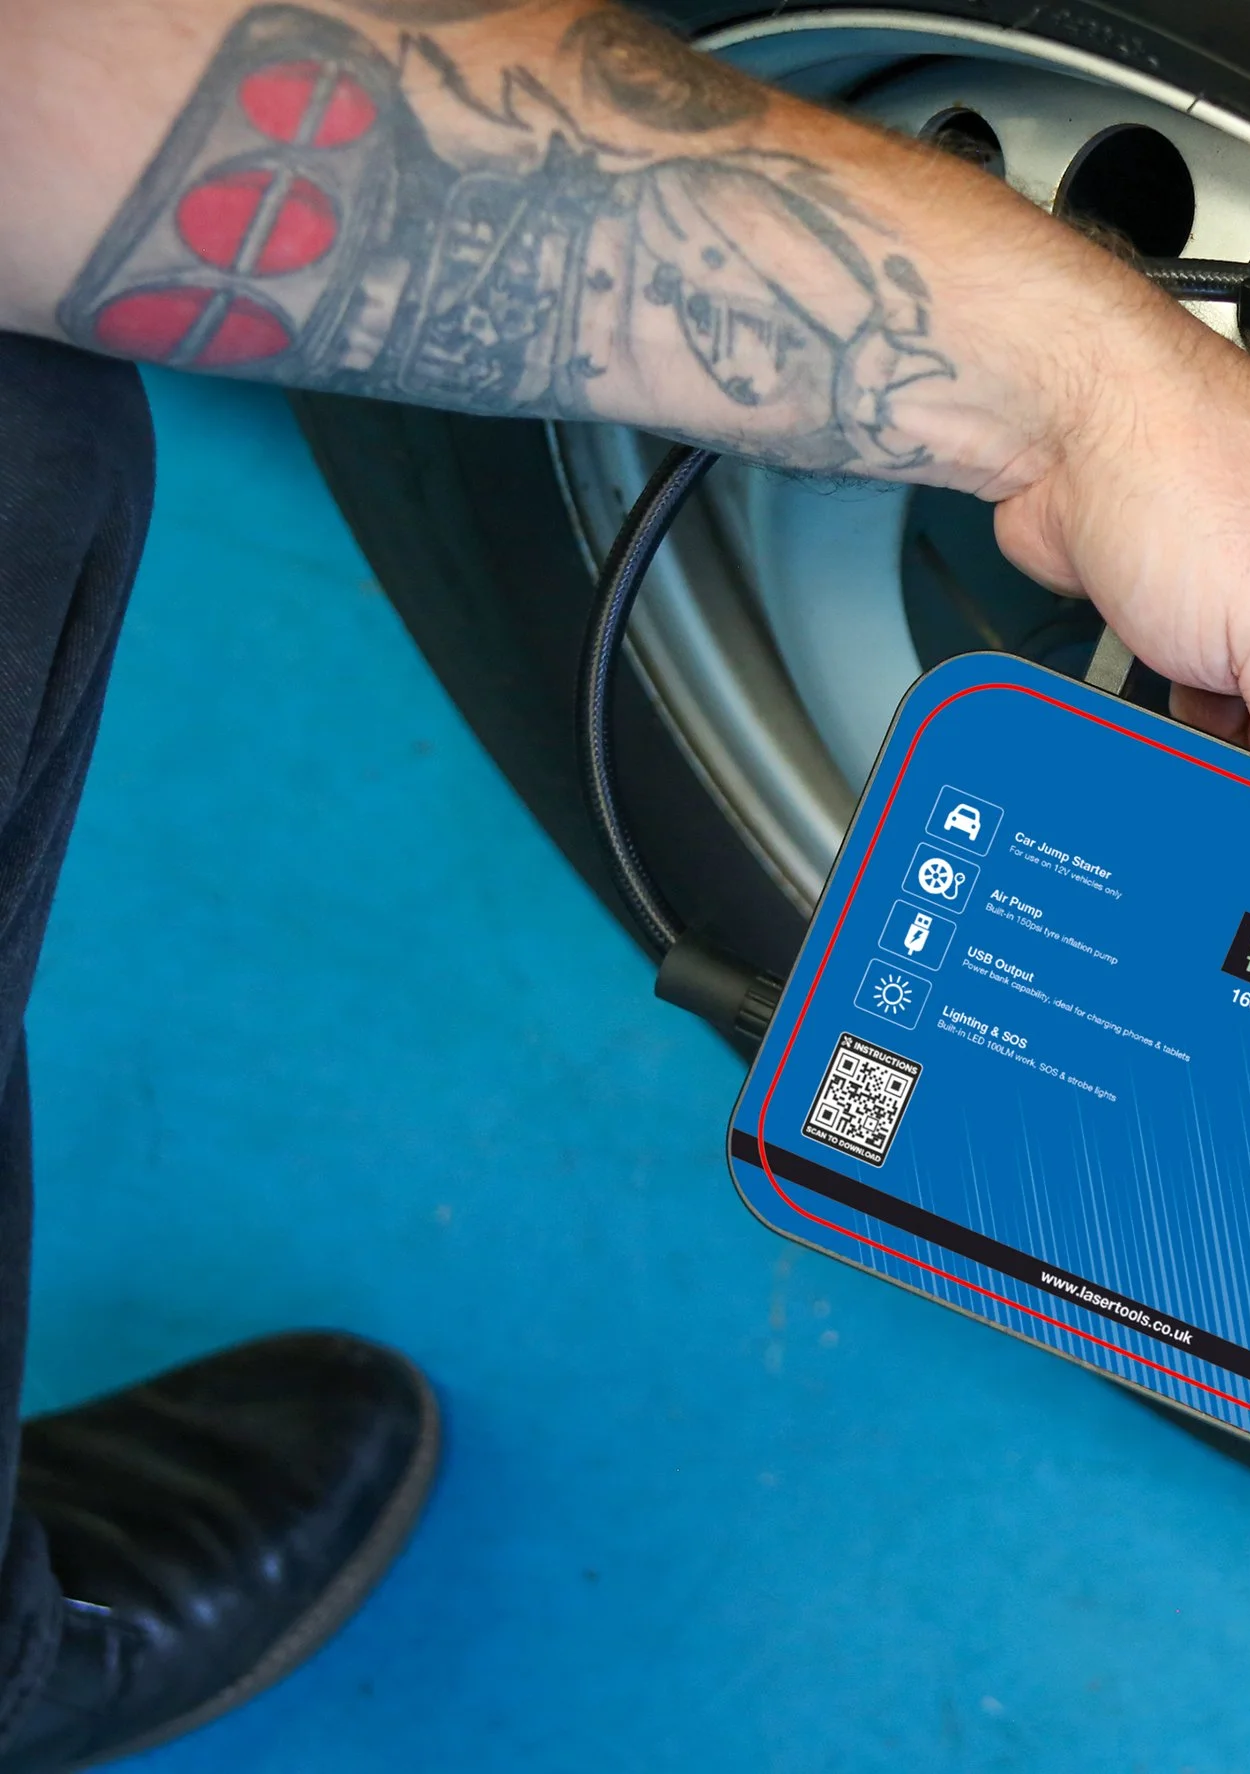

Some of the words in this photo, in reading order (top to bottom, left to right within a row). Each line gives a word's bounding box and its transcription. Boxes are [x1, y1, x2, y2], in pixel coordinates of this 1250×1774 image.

[1009, 845, 1024, 856] For
[1024, 853, 1040, 864] use
[1040, 860, 1052, 869] on
[1054, 864, 1071, 876] 12V
[1070, 873, 1104, 891] vehicles
[1104, 887, 1122, 900] only
[1015, 831, 1036, 848] Car
[1037, 842, 1070, 864] Jump
[1071, 855, 1112, 879] Starter
[990, 889, 1009, 903] Air
[1008, 896, 1043, 919] Pump
[985, 902, 1015, 921] Built-in
[1043, 927, 1061, 940] tyre
[1061, 936, 1093, 954] inflation
[1093, 949, 1119, 965] pump
[967, 946, 994, 965] USB
[994, 958, 1034, 983] Output
[942, 1005, 989, 1035] Lighting
[990, 1026, 999, 1038] &
[1001, 1031, 1028, 1049] SOS
[962, 958, 989, 976] Power
[988, 970, 1010, 985] bank
[1053, 999, 1074, 1012] ideal
[1074, 1006, 1086, 1017] for
[1086, 1013, 1122, 1035] charging
[1122, 1028, 1154, 1047] phones
[1154, 1041, 1162, 1050] &
[1162, 1045, 1191, 1062] tablets
[853, 1041, 918, 1075] INSTRUCTIONS
[937, 1019, 966, 1038] Built-in
[966, 1032, 985, 1045] LED
[987, 1040, 1015, 1058] 100LM
[1039, 1062, 1059, 1077] SOS
[1058, 1071, 1066, 1081] &
[1067, 1076, 1094, 1092] strobe
[1094, 1086, 1117, 1102] lights
[805, 1125, 828, 1139] SCAN
[827, 1134, 839, 1144] TO
[838, 1139, 882, 1163] DOWNLOAD
[1041, 1271, 1193, 1345] www.lasertools.co.uk
